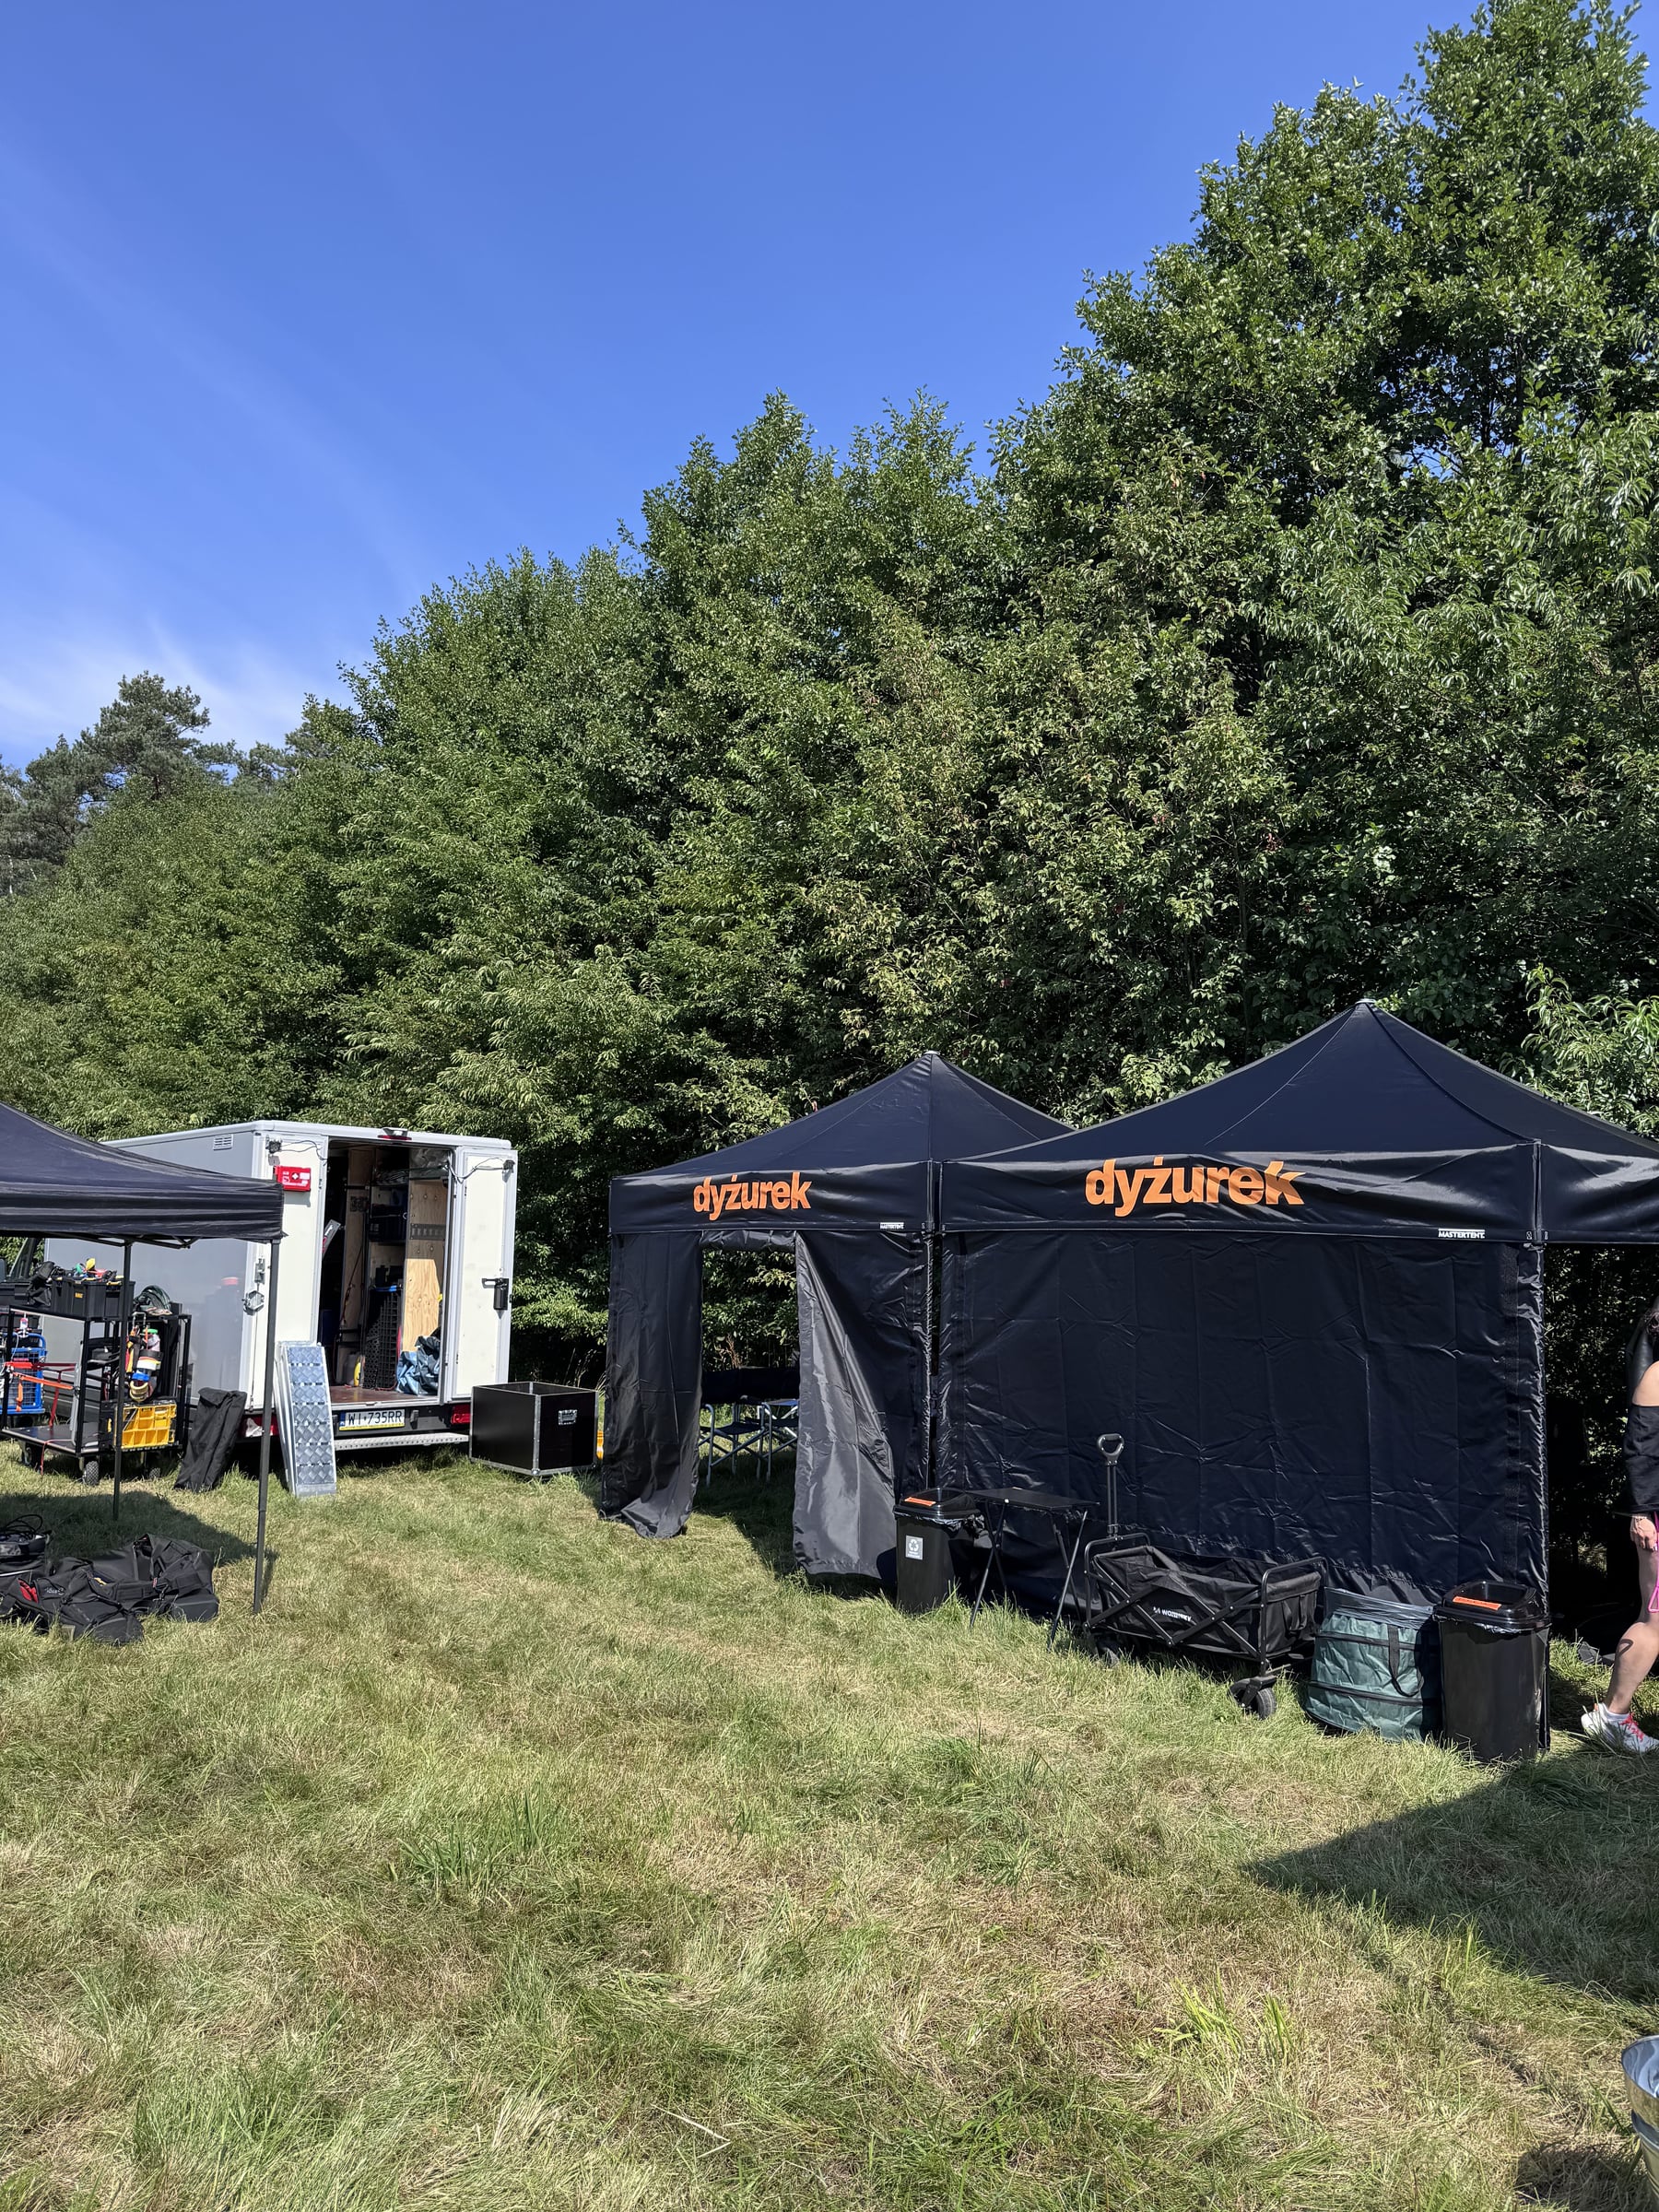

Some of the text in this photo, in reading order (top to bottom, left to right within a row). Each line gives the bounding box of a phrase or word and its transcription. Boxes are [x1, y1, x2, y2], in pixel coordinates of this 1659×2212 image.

[693, 1171, 812, 1221] dyżurek
[1085, 1156, 1306, 1218] dyżurek
[1438, 1230, 1485, 1239] MASTERTENT
[368, 1410, 403, 1424] 735RR
